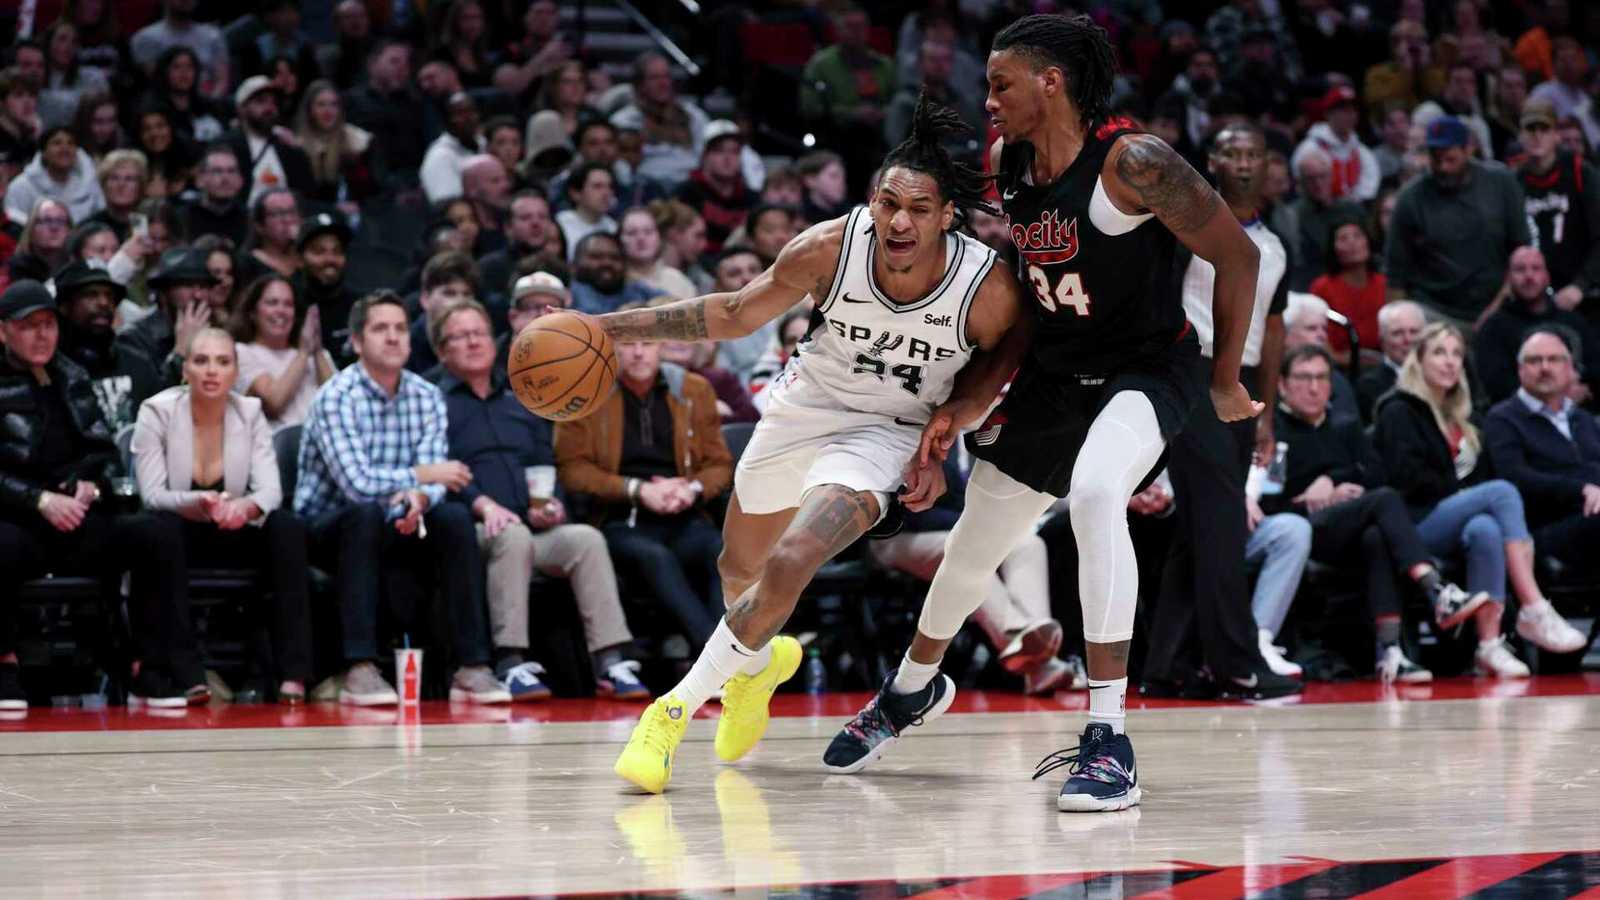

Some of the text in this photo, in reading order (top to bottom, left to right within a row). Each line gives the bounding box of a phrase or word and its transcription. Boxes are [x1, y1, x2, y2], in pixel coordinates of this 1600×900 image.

[1028, 264, 1090, 316] 34
[829, 318, 957, 362] SPURS
[924, 313, 953, 328] Self.
[852, 352, 927, 398] 24
